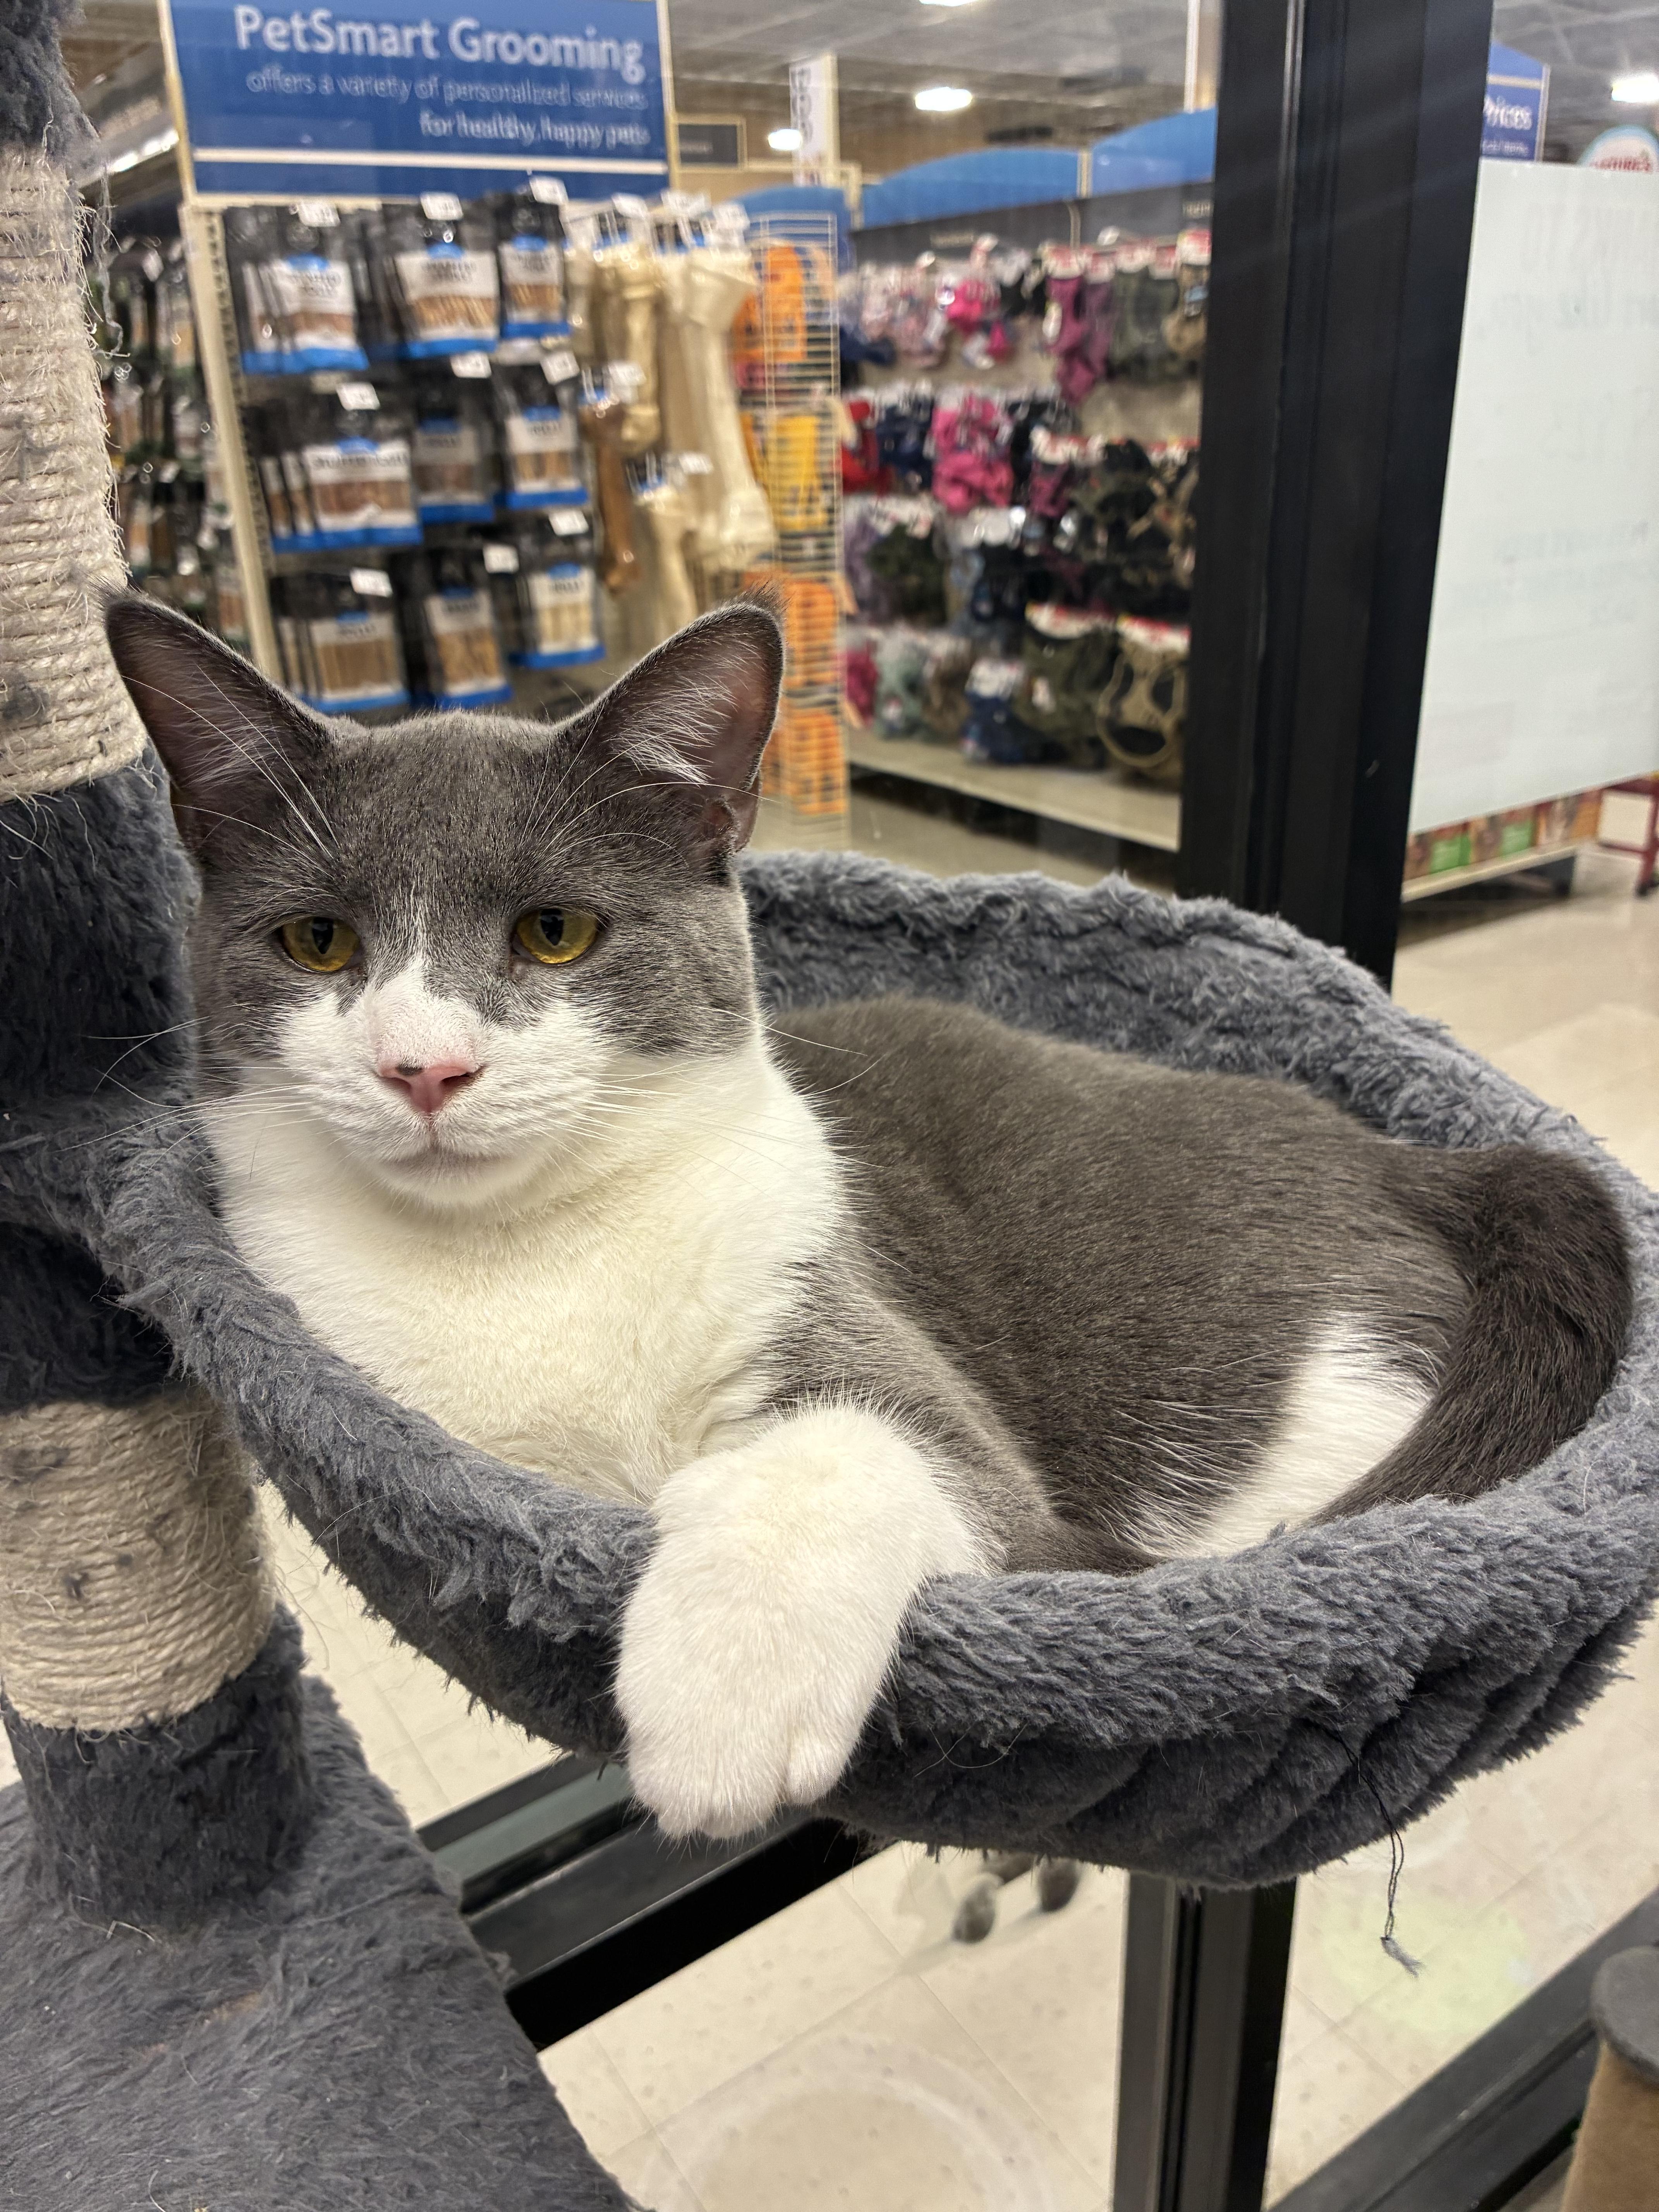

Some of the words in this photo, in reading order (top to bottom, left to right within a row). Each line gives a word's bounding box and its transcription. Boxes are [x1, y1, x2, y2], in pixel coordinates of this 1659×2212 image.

[234, 5, 441, 59] PetSmart
[448, 17, 646, 84] Grooming
[246, 64, 317, 94] offers
[318, 75, 335, 95] a
[336, 76, 412, 105] variety
[414, 74, 439, 100] of
[443, 79, 570, 106] personalized
[574, 88, 649, 110] services
[420, 110, 453, 137] for
[541, 115, 603, 149] happy
[604, 123, 651, 150] pets
